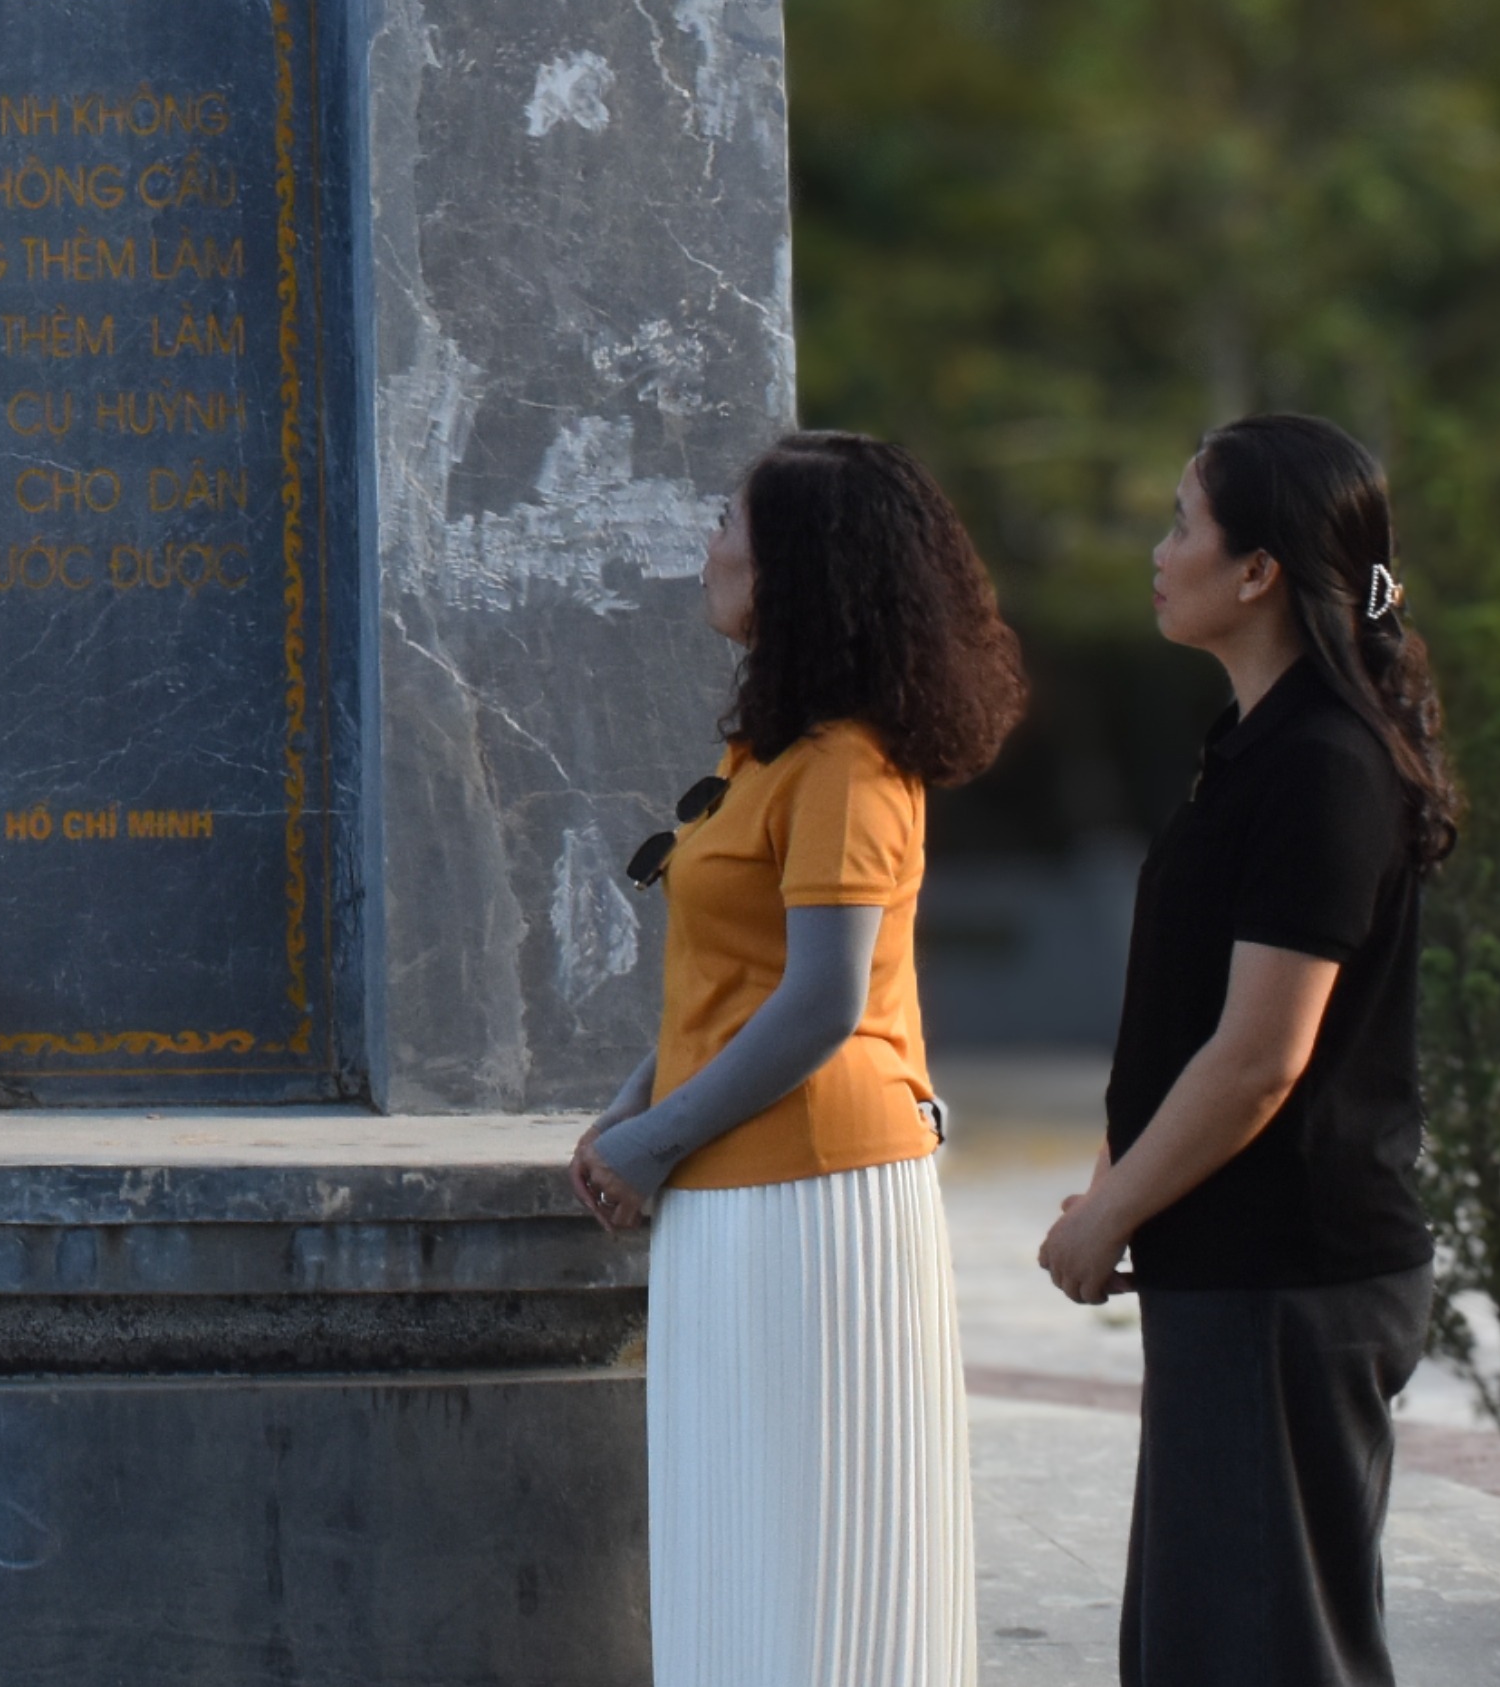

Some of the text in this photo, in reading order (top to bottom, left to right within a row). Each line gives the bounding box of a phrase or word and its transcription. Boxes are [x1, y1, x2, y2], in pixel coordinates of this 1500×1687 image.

[72, 81, 231, 137] KHÔNG
[20, 226, 136, 282] THÈM
[150, 227, 245, 280] LÀM
[0, 303, 116, 358] THÈM
[151, 301, 246, 358] LÀM
[7, 389, 73, 444] CỤ
[96, 378, 247, 437] HUỲNH
[15, 467, 122, 513] CHO
[148, 458, 248, 512] DÂN
[108, 544, 248, 599] ĐƯỢC
[62, 802, 118, 841] CHÍ
[127, 810, 214, 839] MINH
